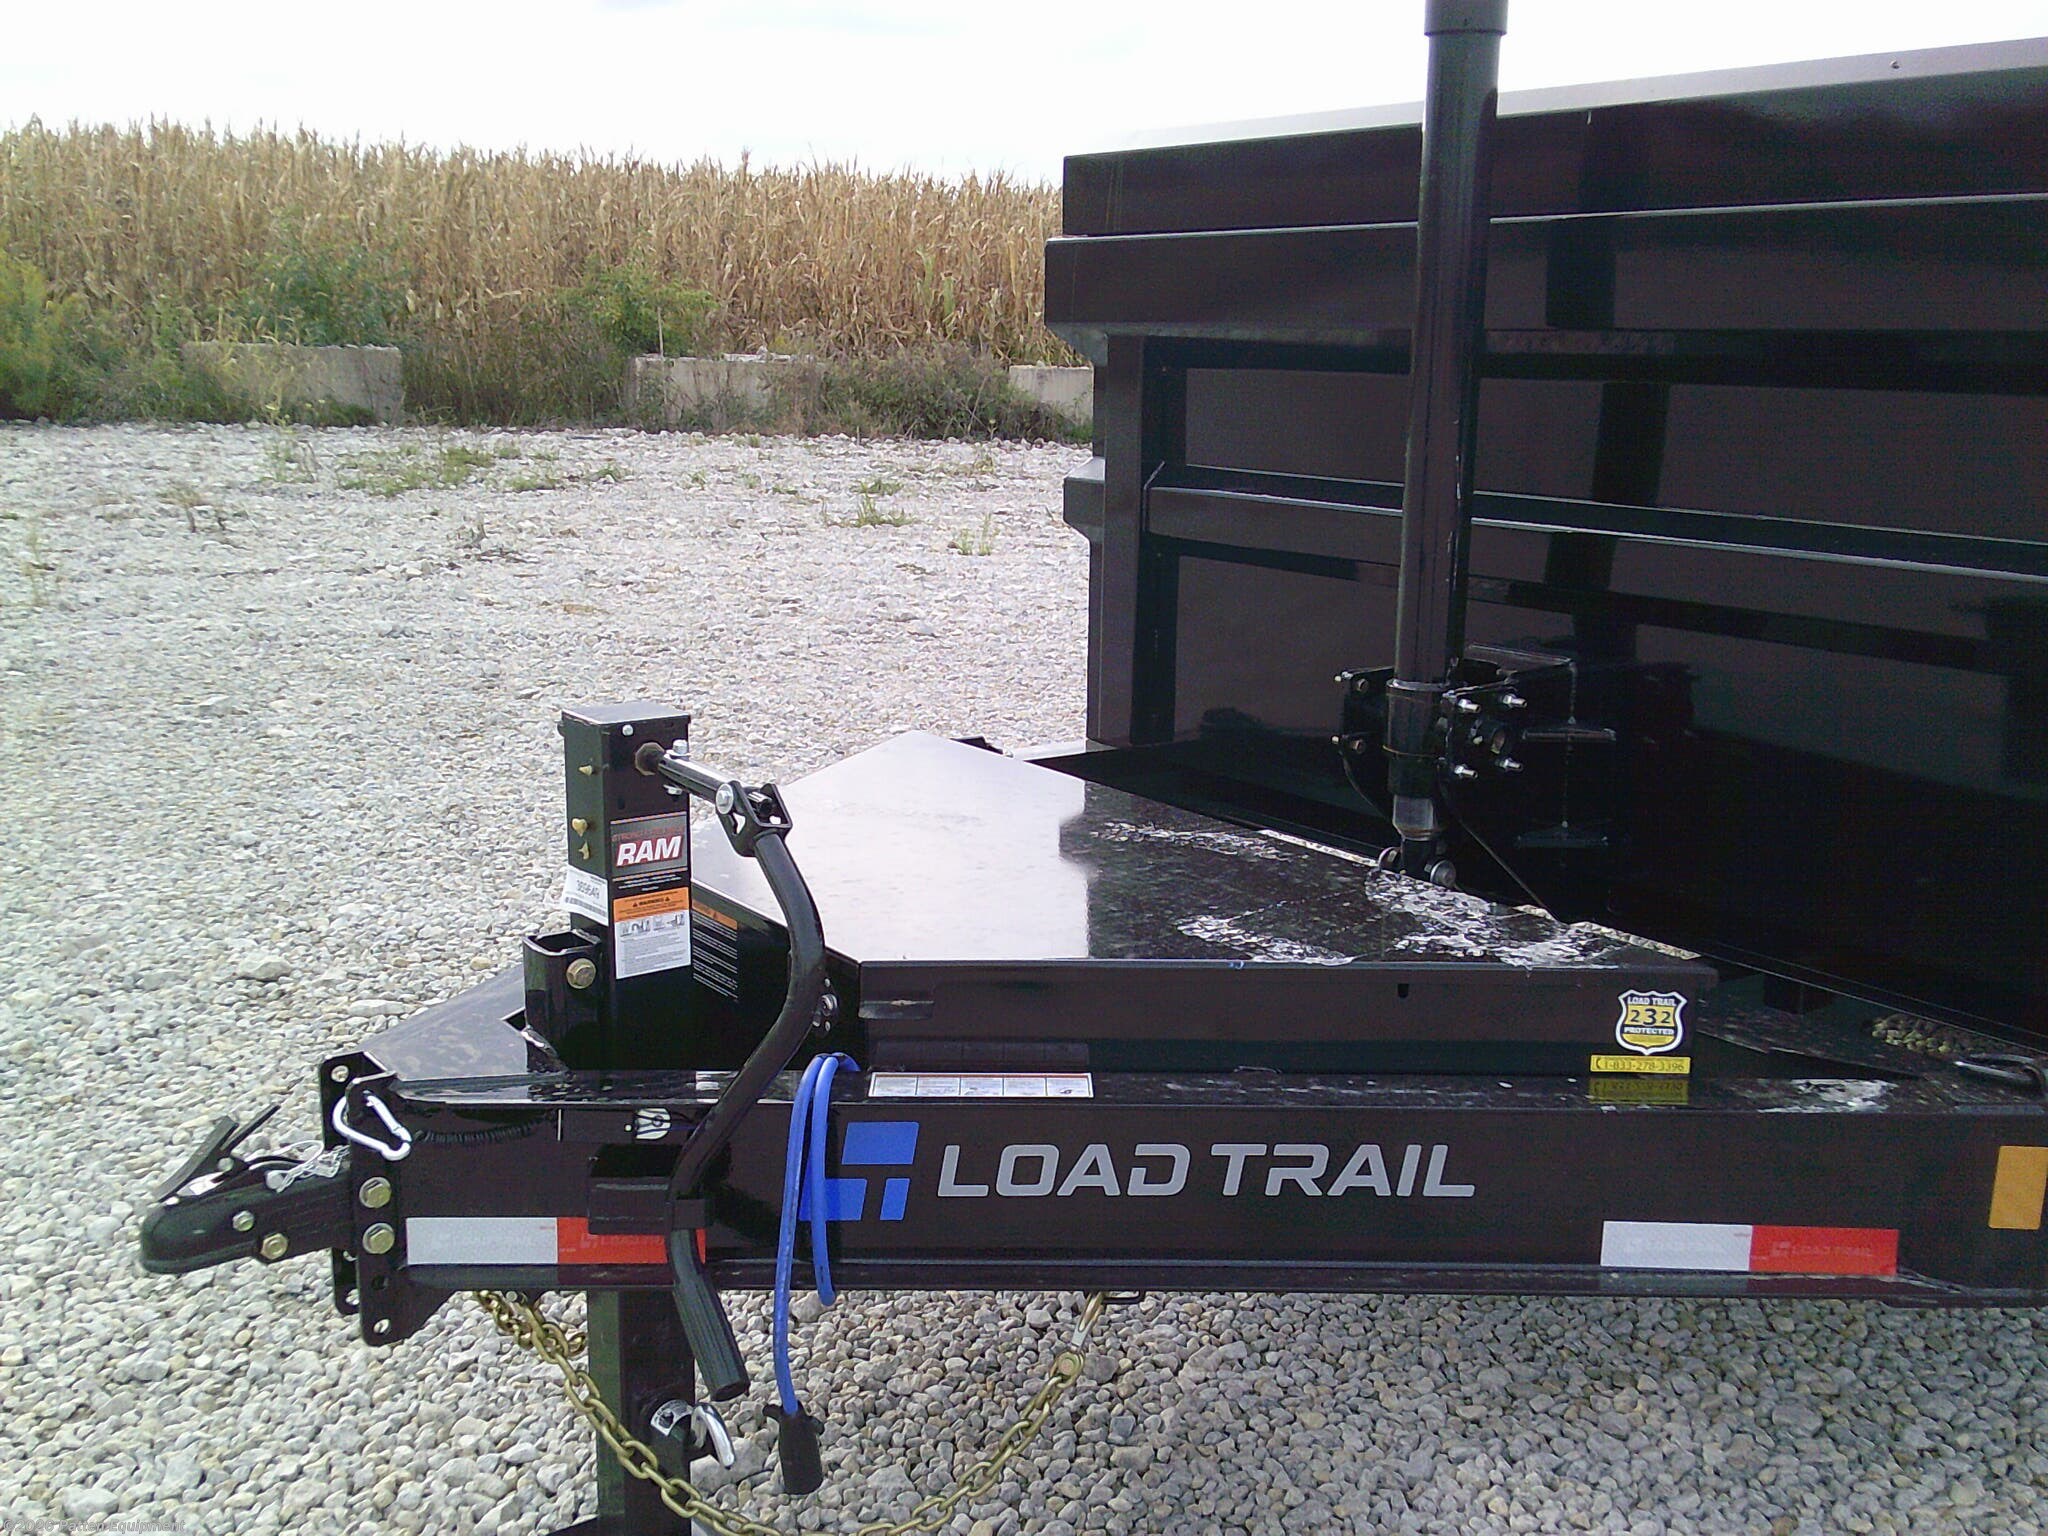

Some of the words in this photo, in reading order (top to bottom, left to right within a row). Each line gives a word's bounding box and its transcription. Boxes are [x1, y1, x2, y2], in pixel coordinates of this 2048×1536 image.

[616, 835, 682, 867] RAM
[1627, 996, 1650, 1005] LOAD
[1652, 997, 1677, 1006] TRAIL
[938, 1144, 1191, 1197] LOAD
[1209, 1144, 1476, 1198] TRAIL
